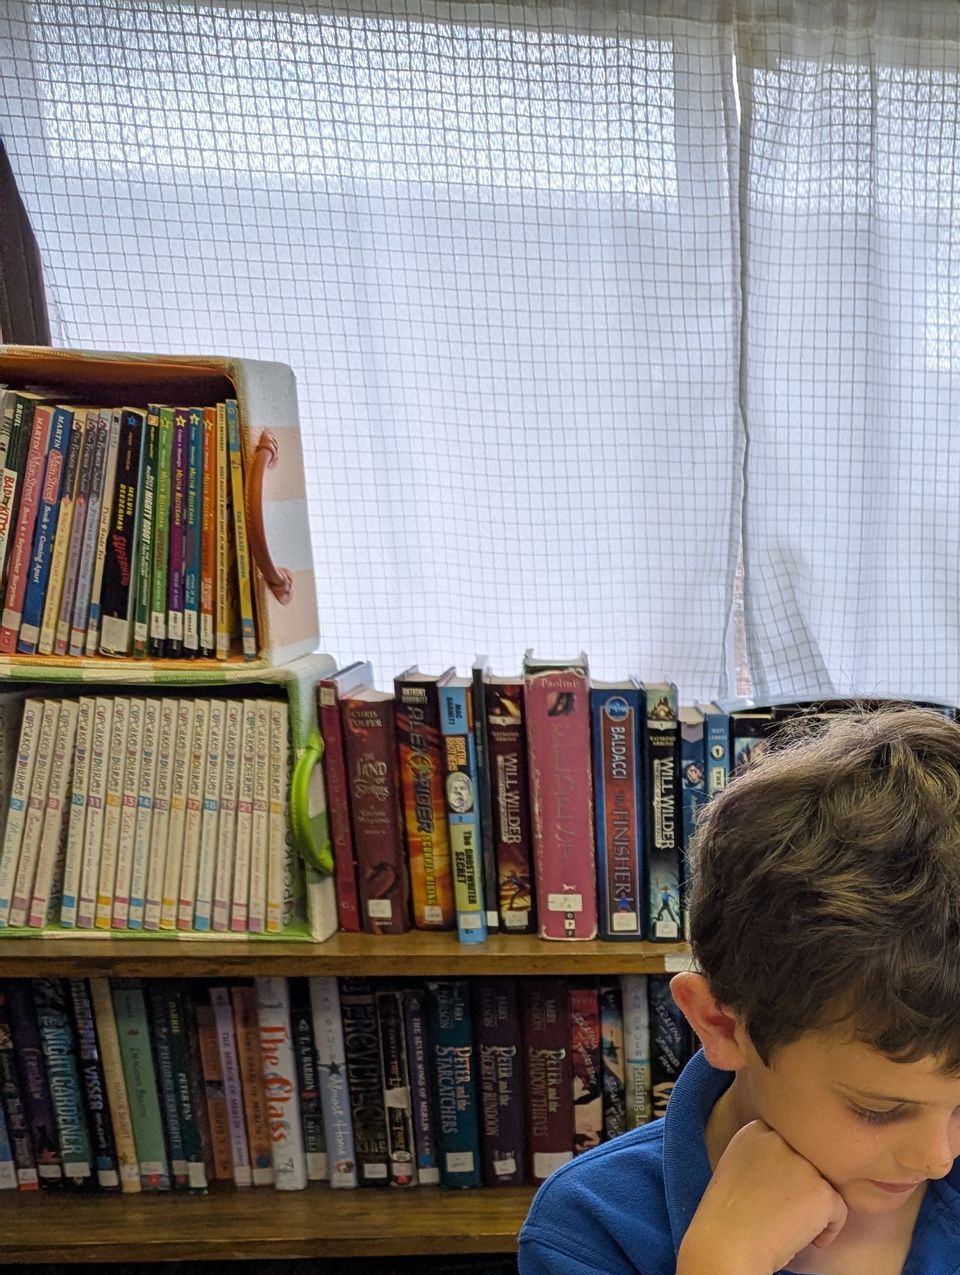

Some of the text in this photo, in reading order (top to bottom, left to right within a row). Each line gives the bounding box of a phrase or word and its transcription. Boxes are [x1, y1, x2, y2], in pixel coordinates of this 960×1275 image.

[13, 403, 23, 427] BRUEL
[32, 417, 44, 449] MARTIN
[53, 415, 65, 449] MARTIN
[126, 486, 135, 516] MELVIN
[143, 491, 154, 519] MIGHTY
[141, 519, 151, 544] ROBOT
[34, 535, 46, 562] Coming
[33, 562, 43, 583] Apart
[611, 726, 627, 779] BALDACCI
[505, 754, 518, 787] WILL
[506, 791, 521, 843] WILDER
[660, 757, 675, 850] WILL WILDER
[463, 831, 472, 846] The
[613, 810, 632, 894] FINISHER
[84, 1066, 104, 1110] VISSER
